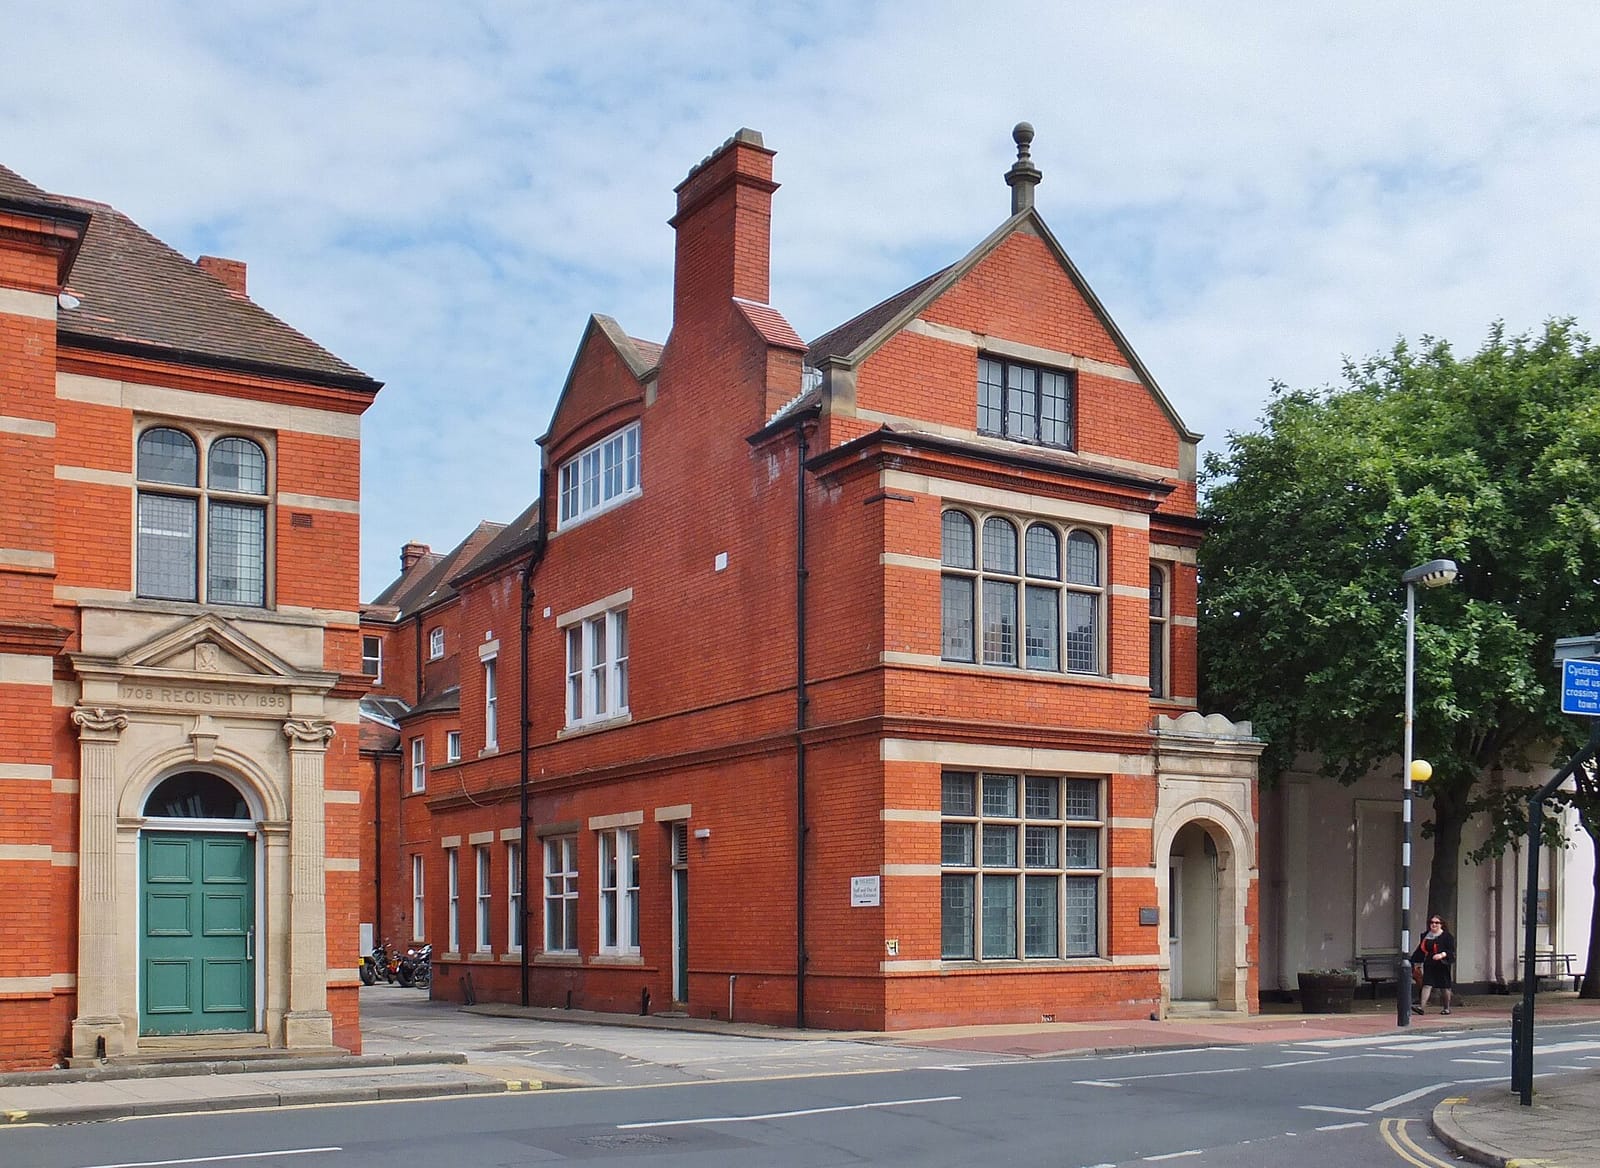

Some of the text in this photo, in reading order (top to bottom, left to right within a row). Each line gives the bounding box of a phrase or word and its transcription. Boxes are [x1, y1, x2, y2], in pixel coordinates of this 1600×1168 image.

[1568, 665, 1599, 676] Cyclists
[1575, 678, 1589, 686] and
[122, 687, 153, 700] 1708
[161, 689, 249, 707] REGISTRY
[1566, 689, 1598, 700] crossing
[1578, 700, 1597, 708] town
